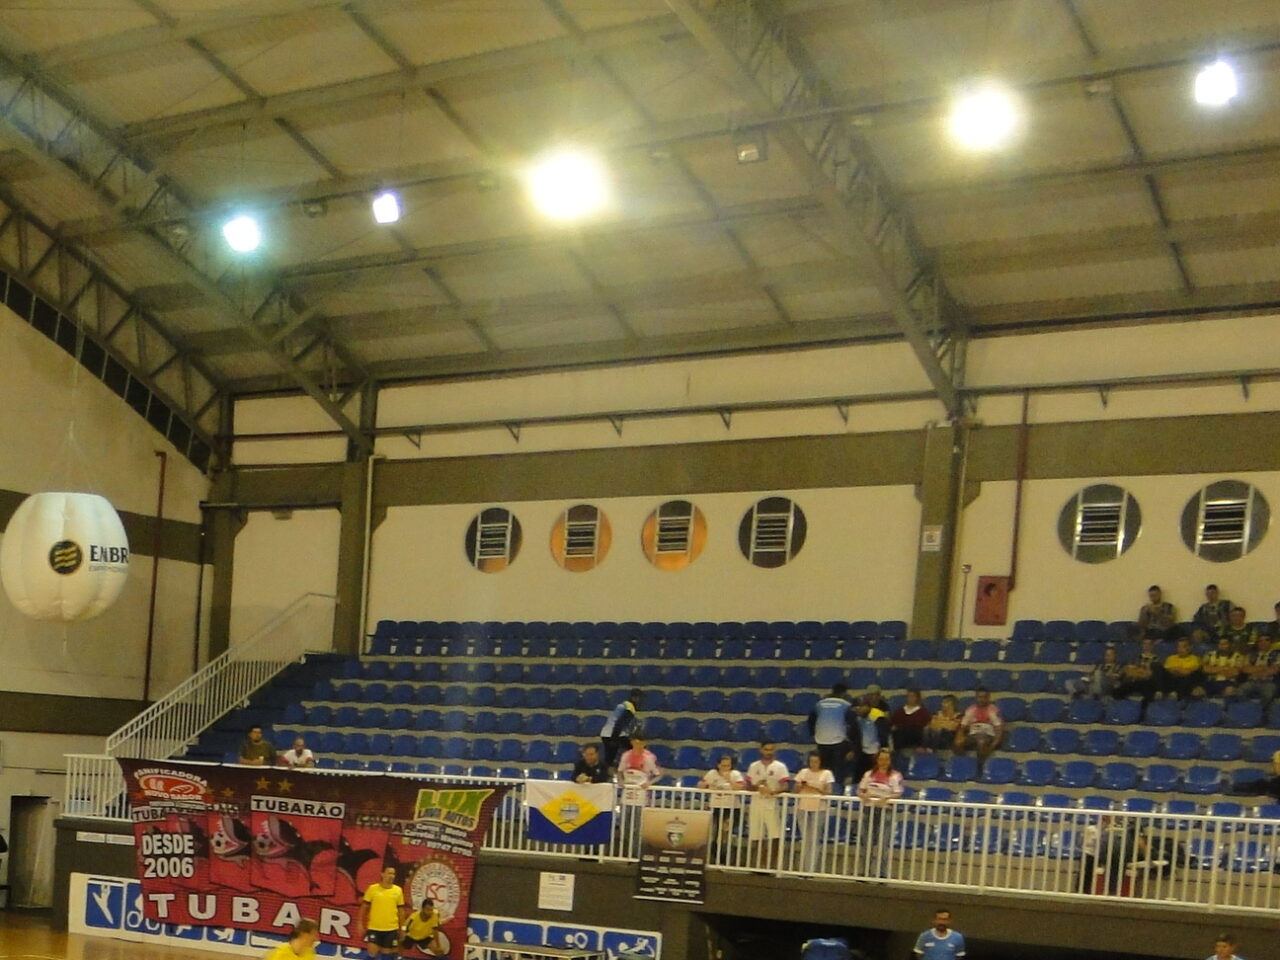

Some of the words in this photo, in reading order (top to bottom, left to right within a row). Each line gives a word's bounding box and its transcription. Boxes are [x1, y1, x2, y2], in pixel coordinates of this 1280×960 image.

[134, 768, 208, 787] PANIFICADORA
[252, 797, 343, 817] TUBARÃO
[419, 790, 494, 818] LUX
[142, 834, 195, 855] DESDE
[144, 857, 195, 878] 2006
